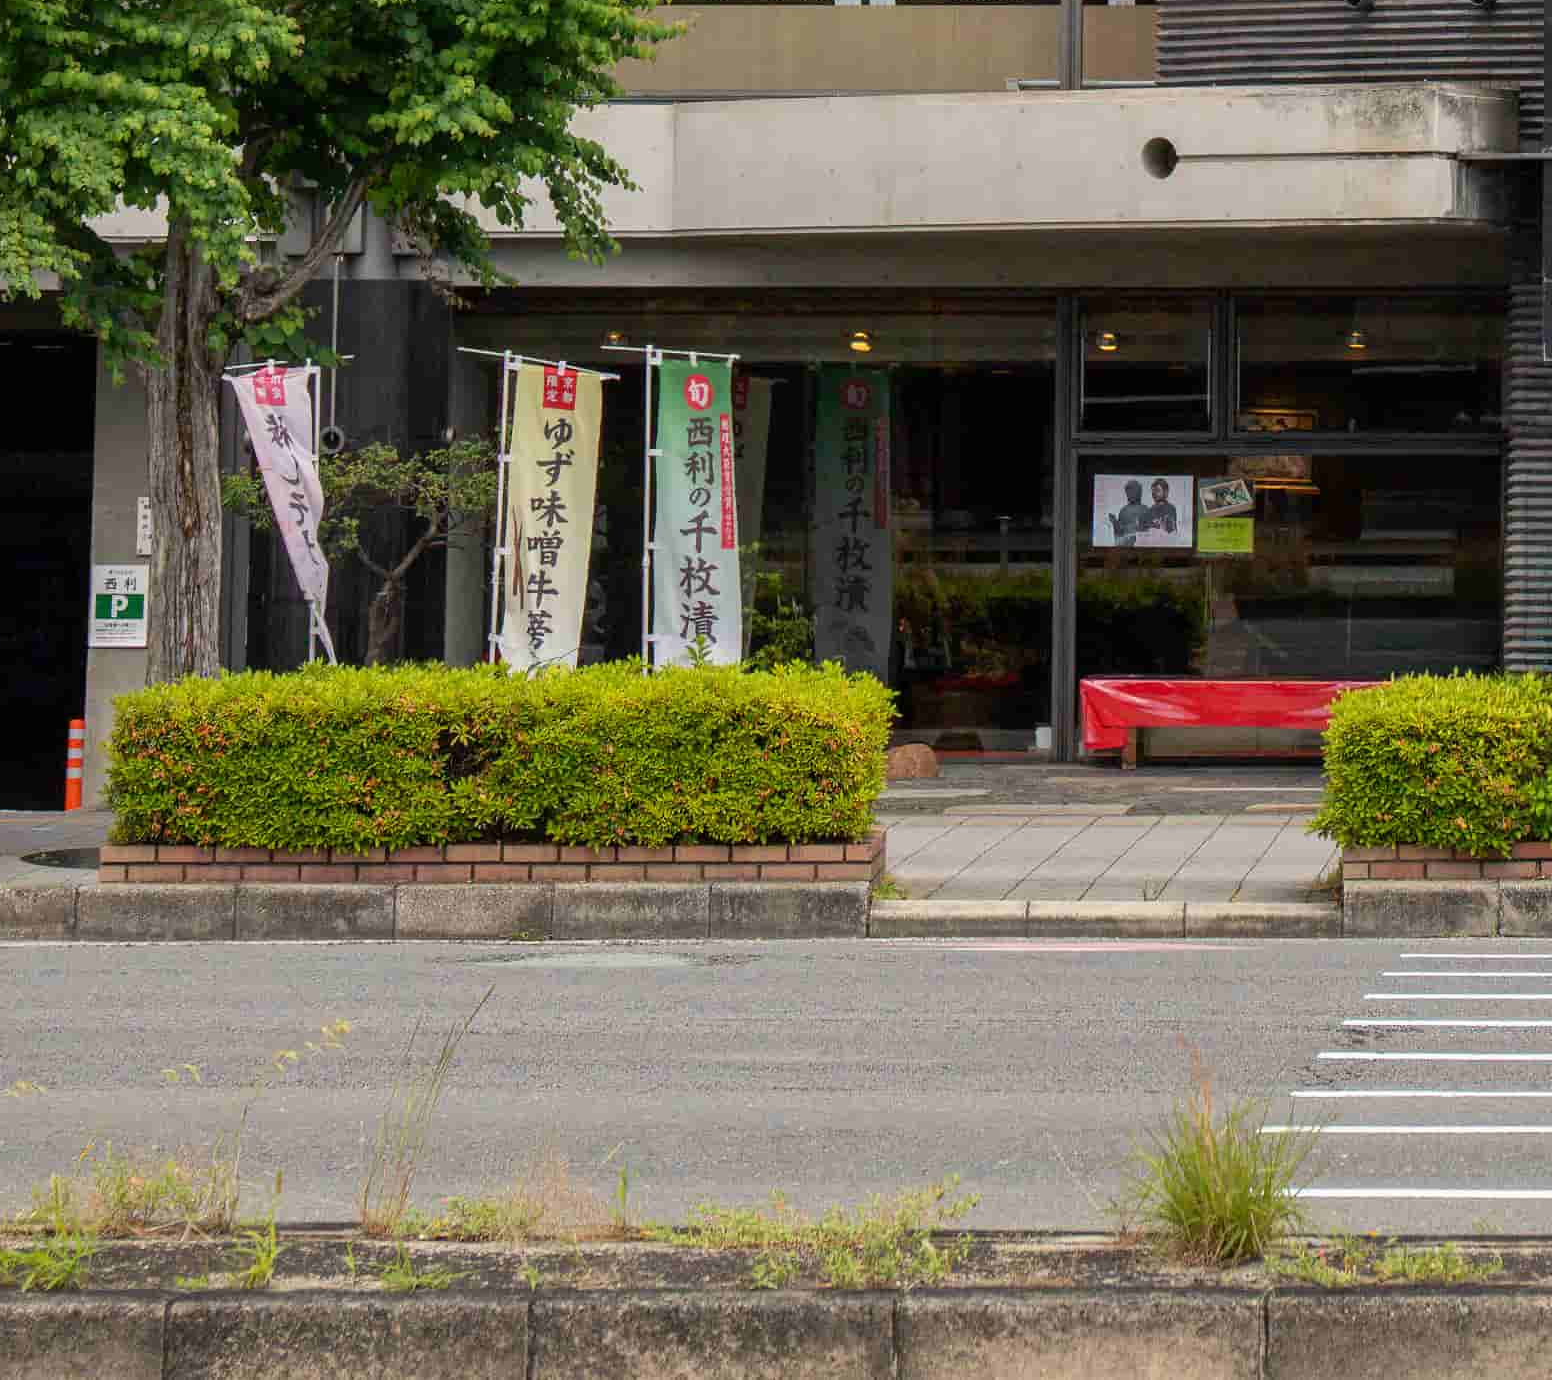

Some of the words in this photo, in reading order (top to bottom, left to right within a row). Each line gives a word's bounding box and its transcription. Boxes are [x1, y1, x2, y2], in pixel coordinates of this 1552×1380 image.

[688, 380, 709, 407] 旬
[680, 417, 720, 644] 西利の千枚漬
[111, 595, 129, 618] P
